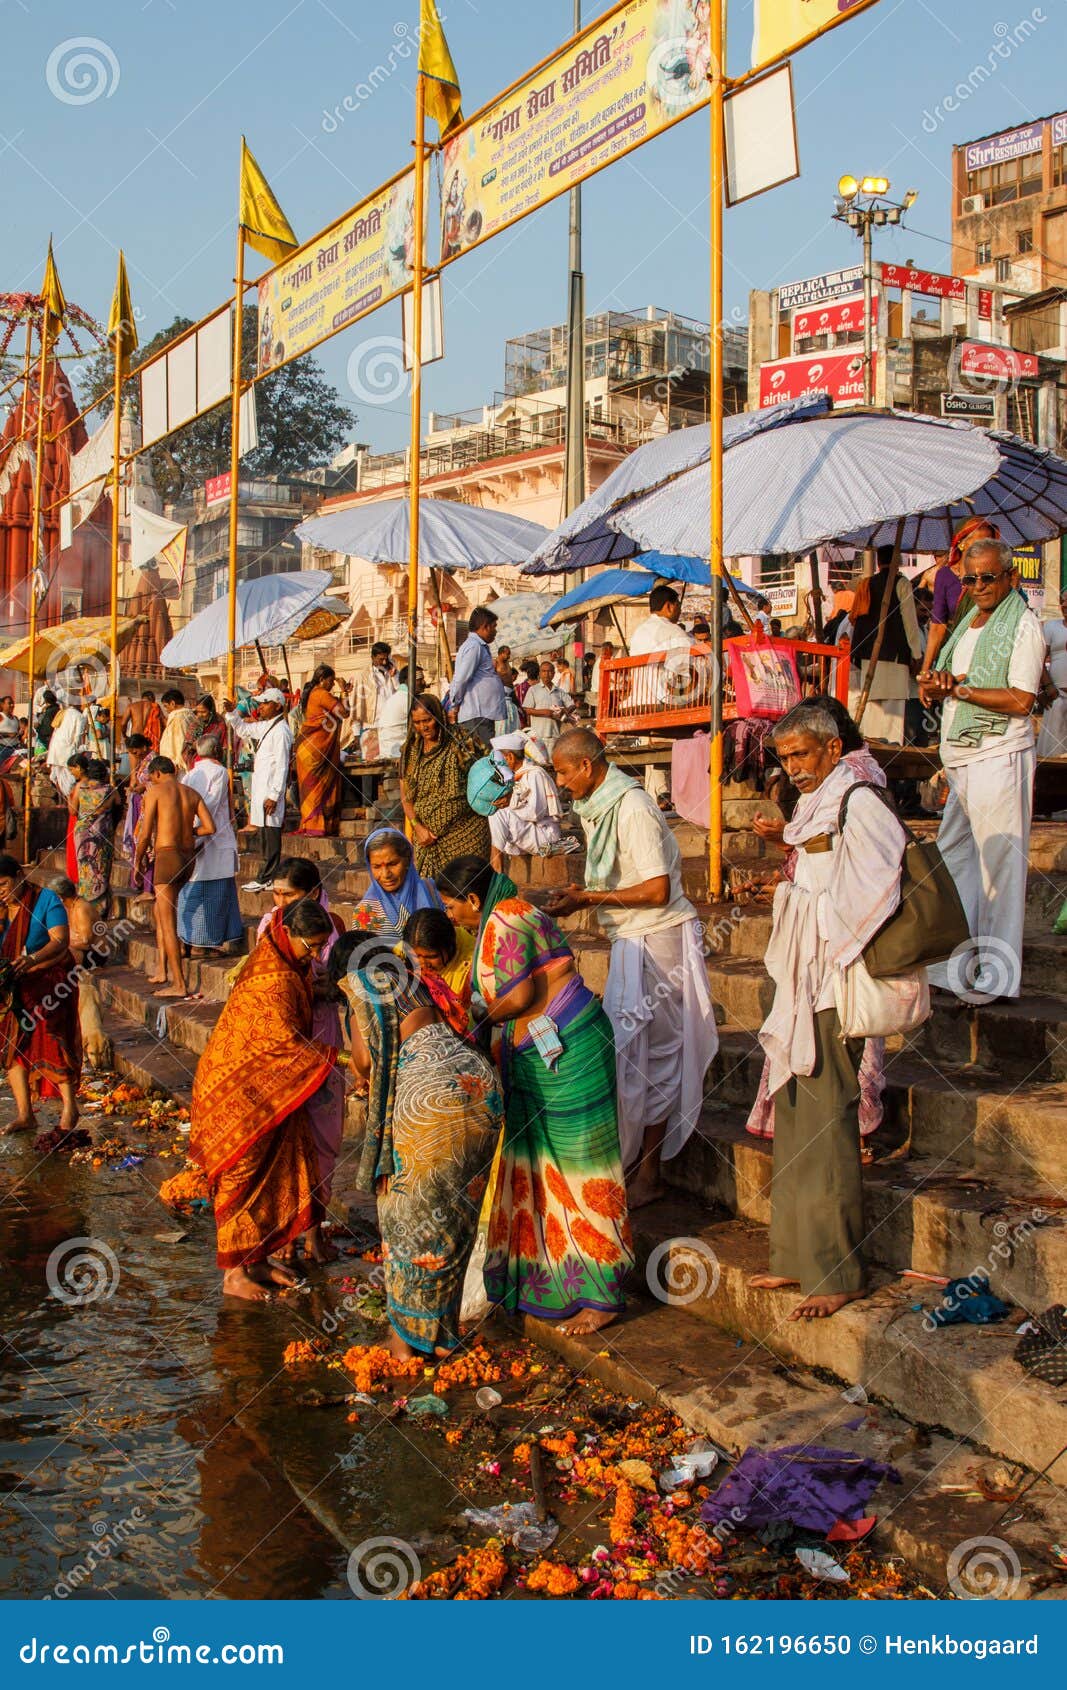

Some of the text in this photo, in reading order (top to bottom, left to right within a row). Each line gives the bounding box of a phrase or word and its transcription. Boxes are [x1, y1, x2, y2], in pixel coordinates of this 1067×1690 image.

[968, 136, 1042, 167] Shri RESTAURANT
[781, 277, 825, 299] REPLICA
[836, 321, 854, 332] airtel
[763, 391, 791, 405] airtel
[838, 382, 864, 395] airte
[946, 401, 992, 411] OSHO GLIMPSE
